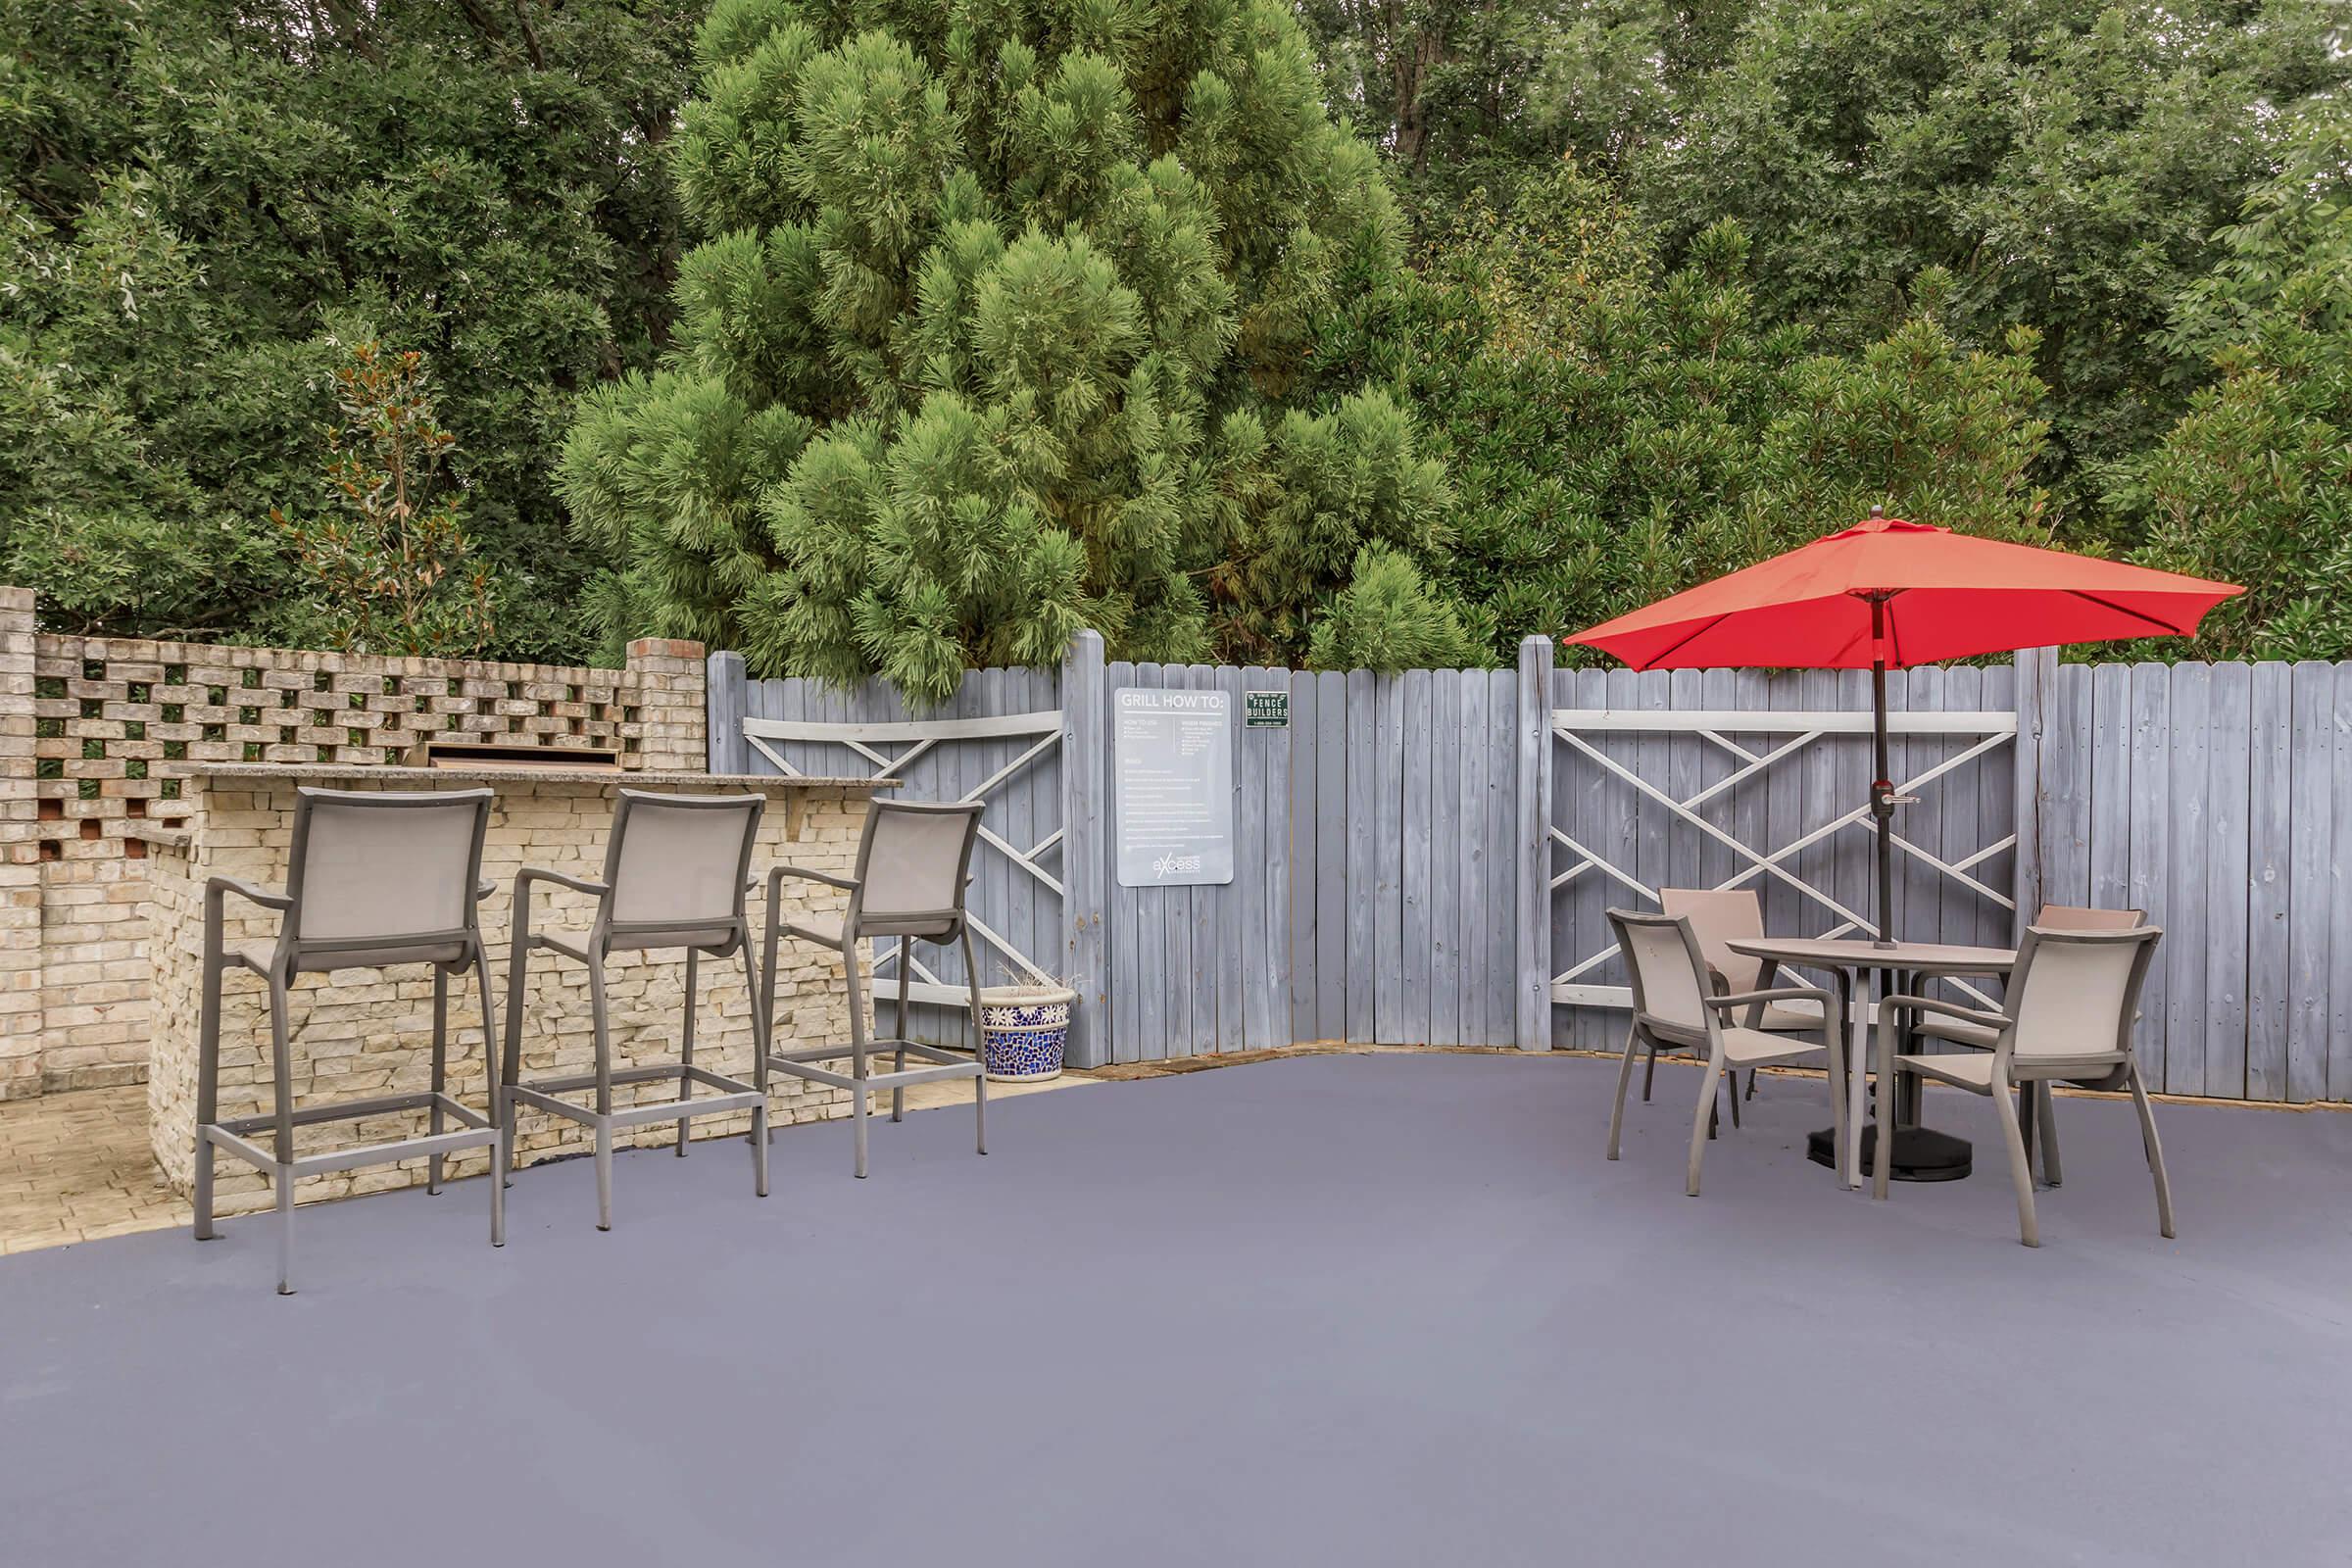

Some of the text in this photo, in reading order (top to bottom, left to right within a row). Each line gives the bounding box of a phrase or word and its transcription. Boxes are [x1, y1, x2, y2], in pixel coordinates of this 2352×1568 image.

[1121, 693, 1224, 709] GRILL HOW TO:
[1253, 699, 1282, 708] FENCE
[1248, 708, 1288, 716] BUILDERS
